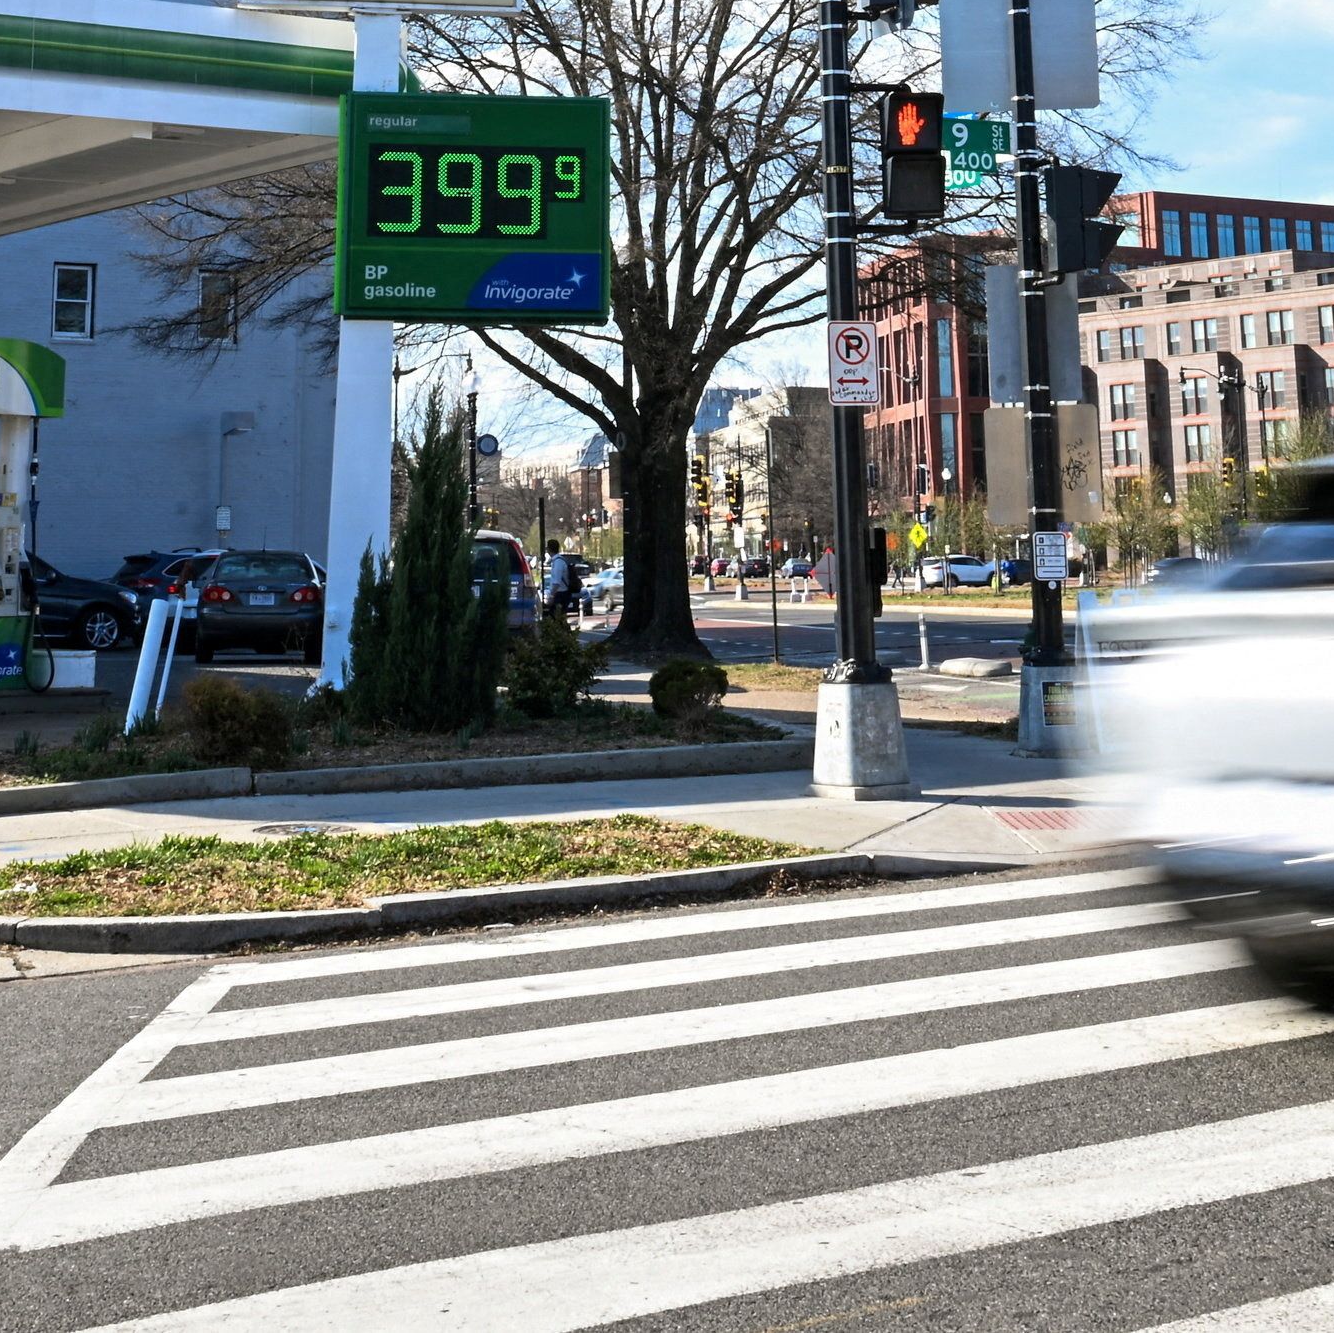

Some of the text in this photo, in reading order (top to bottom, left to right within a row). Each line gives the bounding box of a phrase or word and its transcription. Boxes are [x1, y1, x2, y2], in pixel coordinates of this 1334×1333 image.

[369, 116, 418, 129] regular
[951, 123, 1003, 147] 9 St
[992, 138, 1005, 151] SE
[954, 152, 993, 170] 400
[365, 265, 388, 280] BP
[492, 278, 509, 286] with
[364, 283, 437, 300] gasoline
[485, 284, 573, 303] Invigorate
